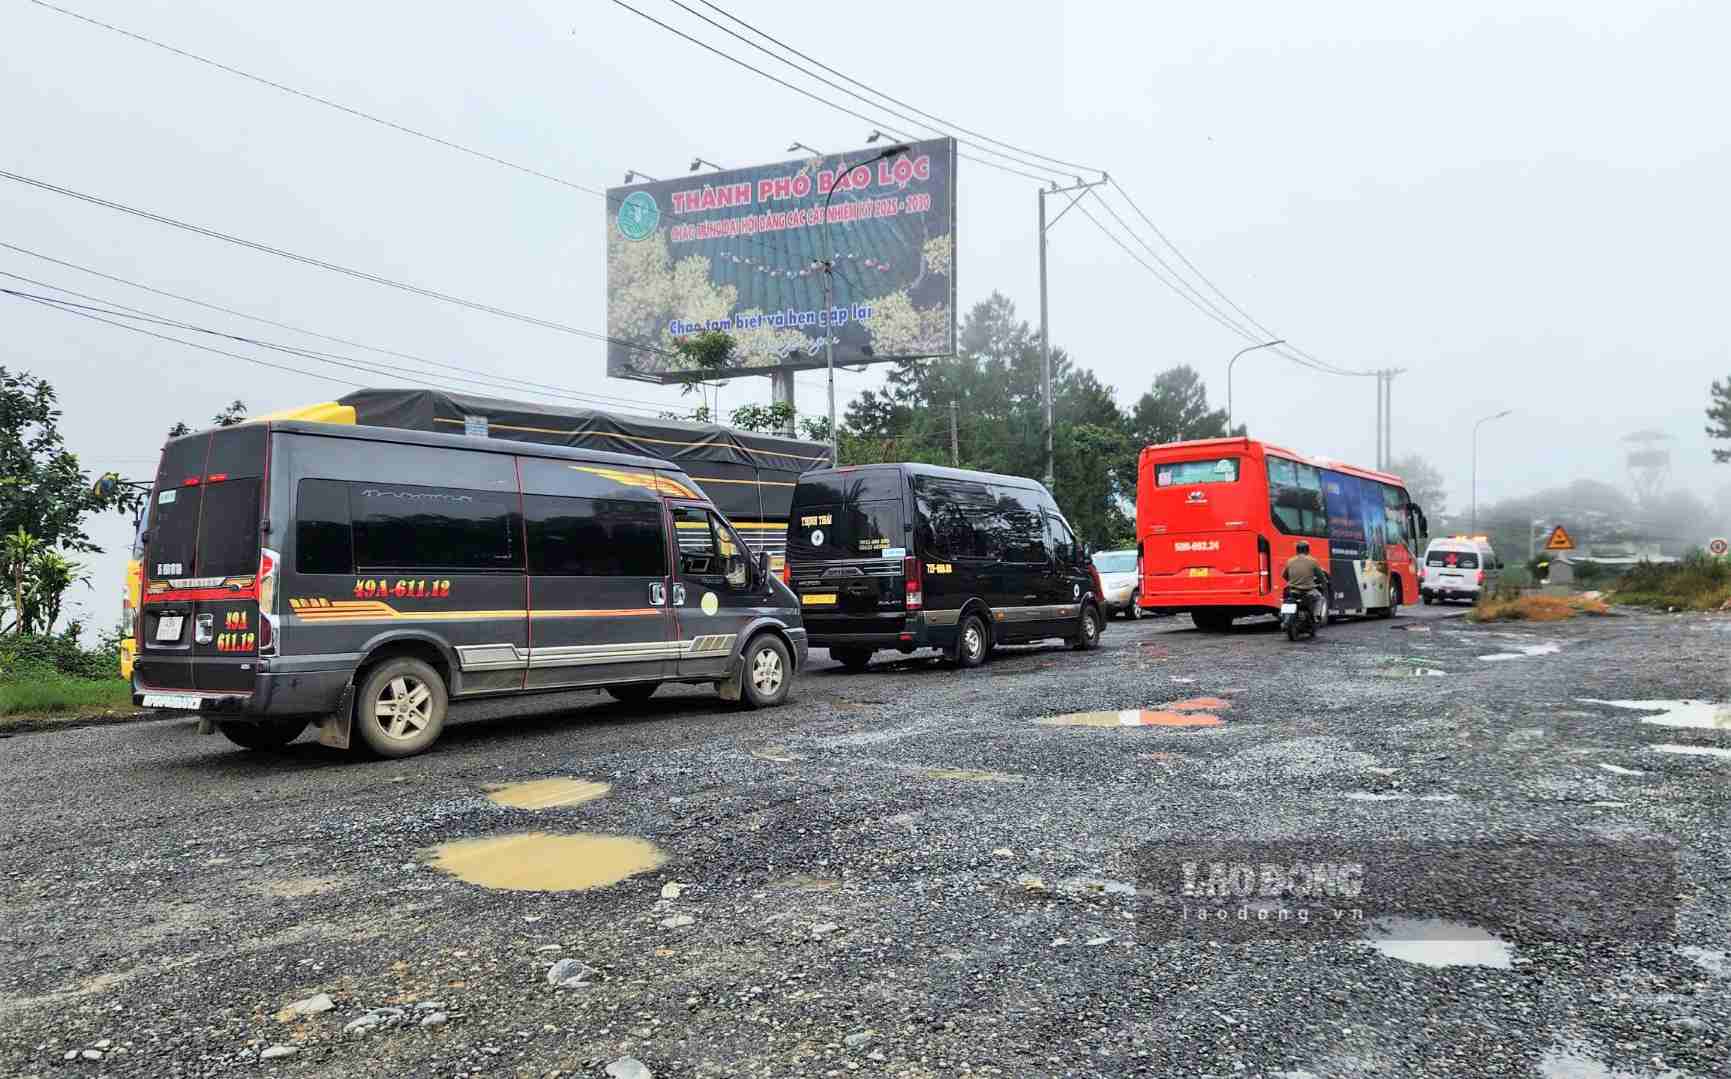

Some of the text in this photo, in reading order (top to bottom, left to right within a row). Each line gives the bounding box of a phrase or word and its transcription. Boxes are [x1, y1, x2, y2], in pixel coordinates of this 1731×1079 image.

[672, 184, 752, 214] THÀNH
[758, 167, 811, 203] PHỐ
[879, 152, 930, 190] LỘC
[354, 578, 450, 599] 49A-611.12
[224, 610, 248, 631] 49A
[217, 632, 255, 653] 611.12
